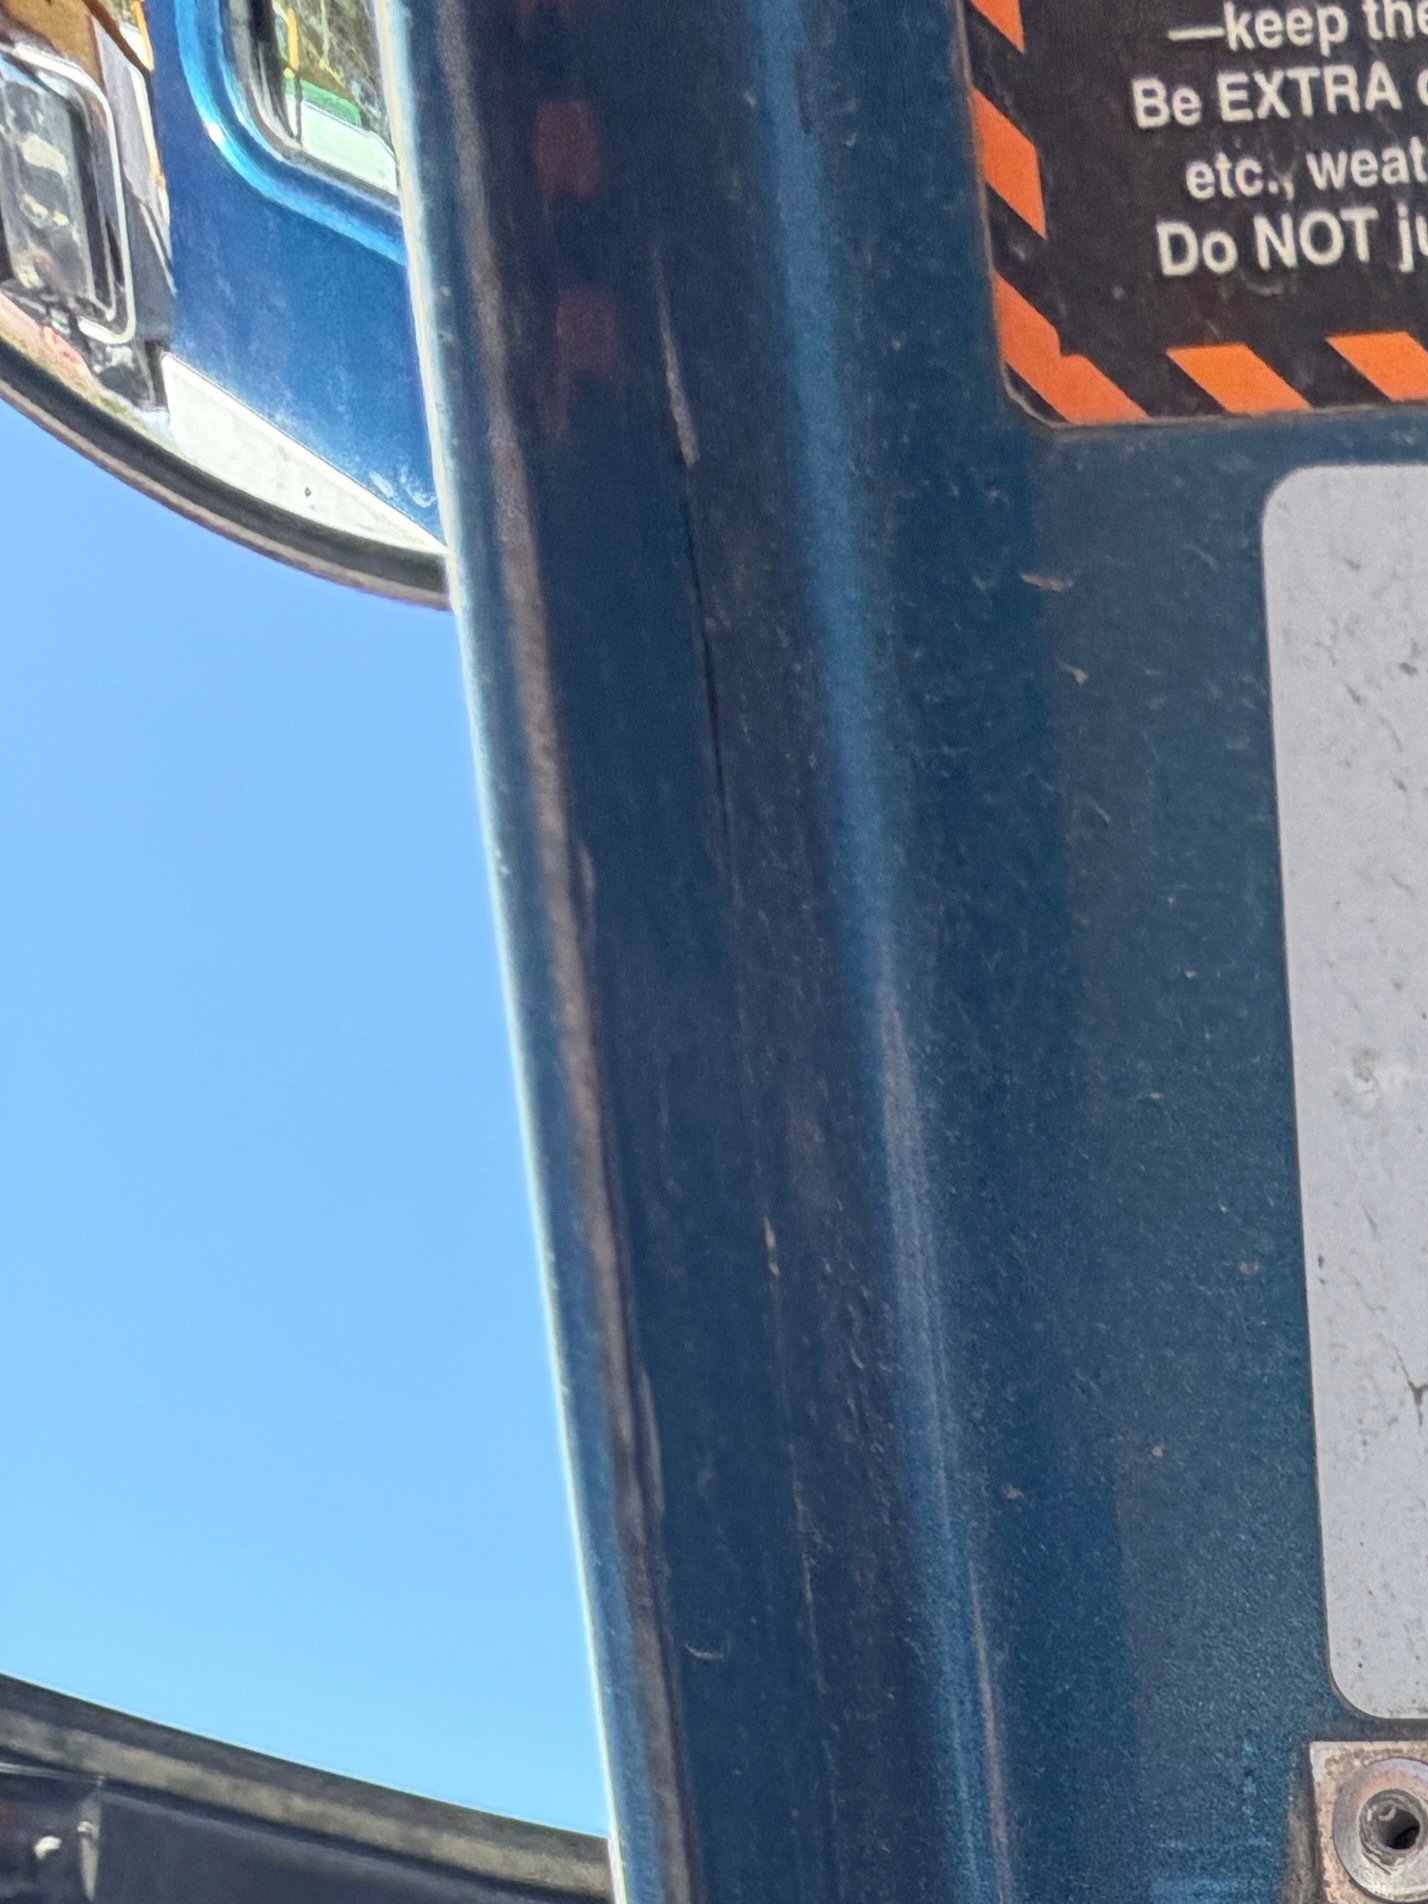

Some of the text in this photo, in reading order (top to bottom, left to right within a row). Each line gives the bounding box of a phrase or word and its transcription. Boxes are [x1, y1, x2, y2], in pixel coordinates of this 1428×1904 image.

[1131, 76, 1202, 129] Be
[1216, 60, 1402, 122] EXTRA
[1185, 150, 1295, 201] etc.,
[1155, 219, 1239, 277] Do
[1252, 205, 1380, 272] NOT
